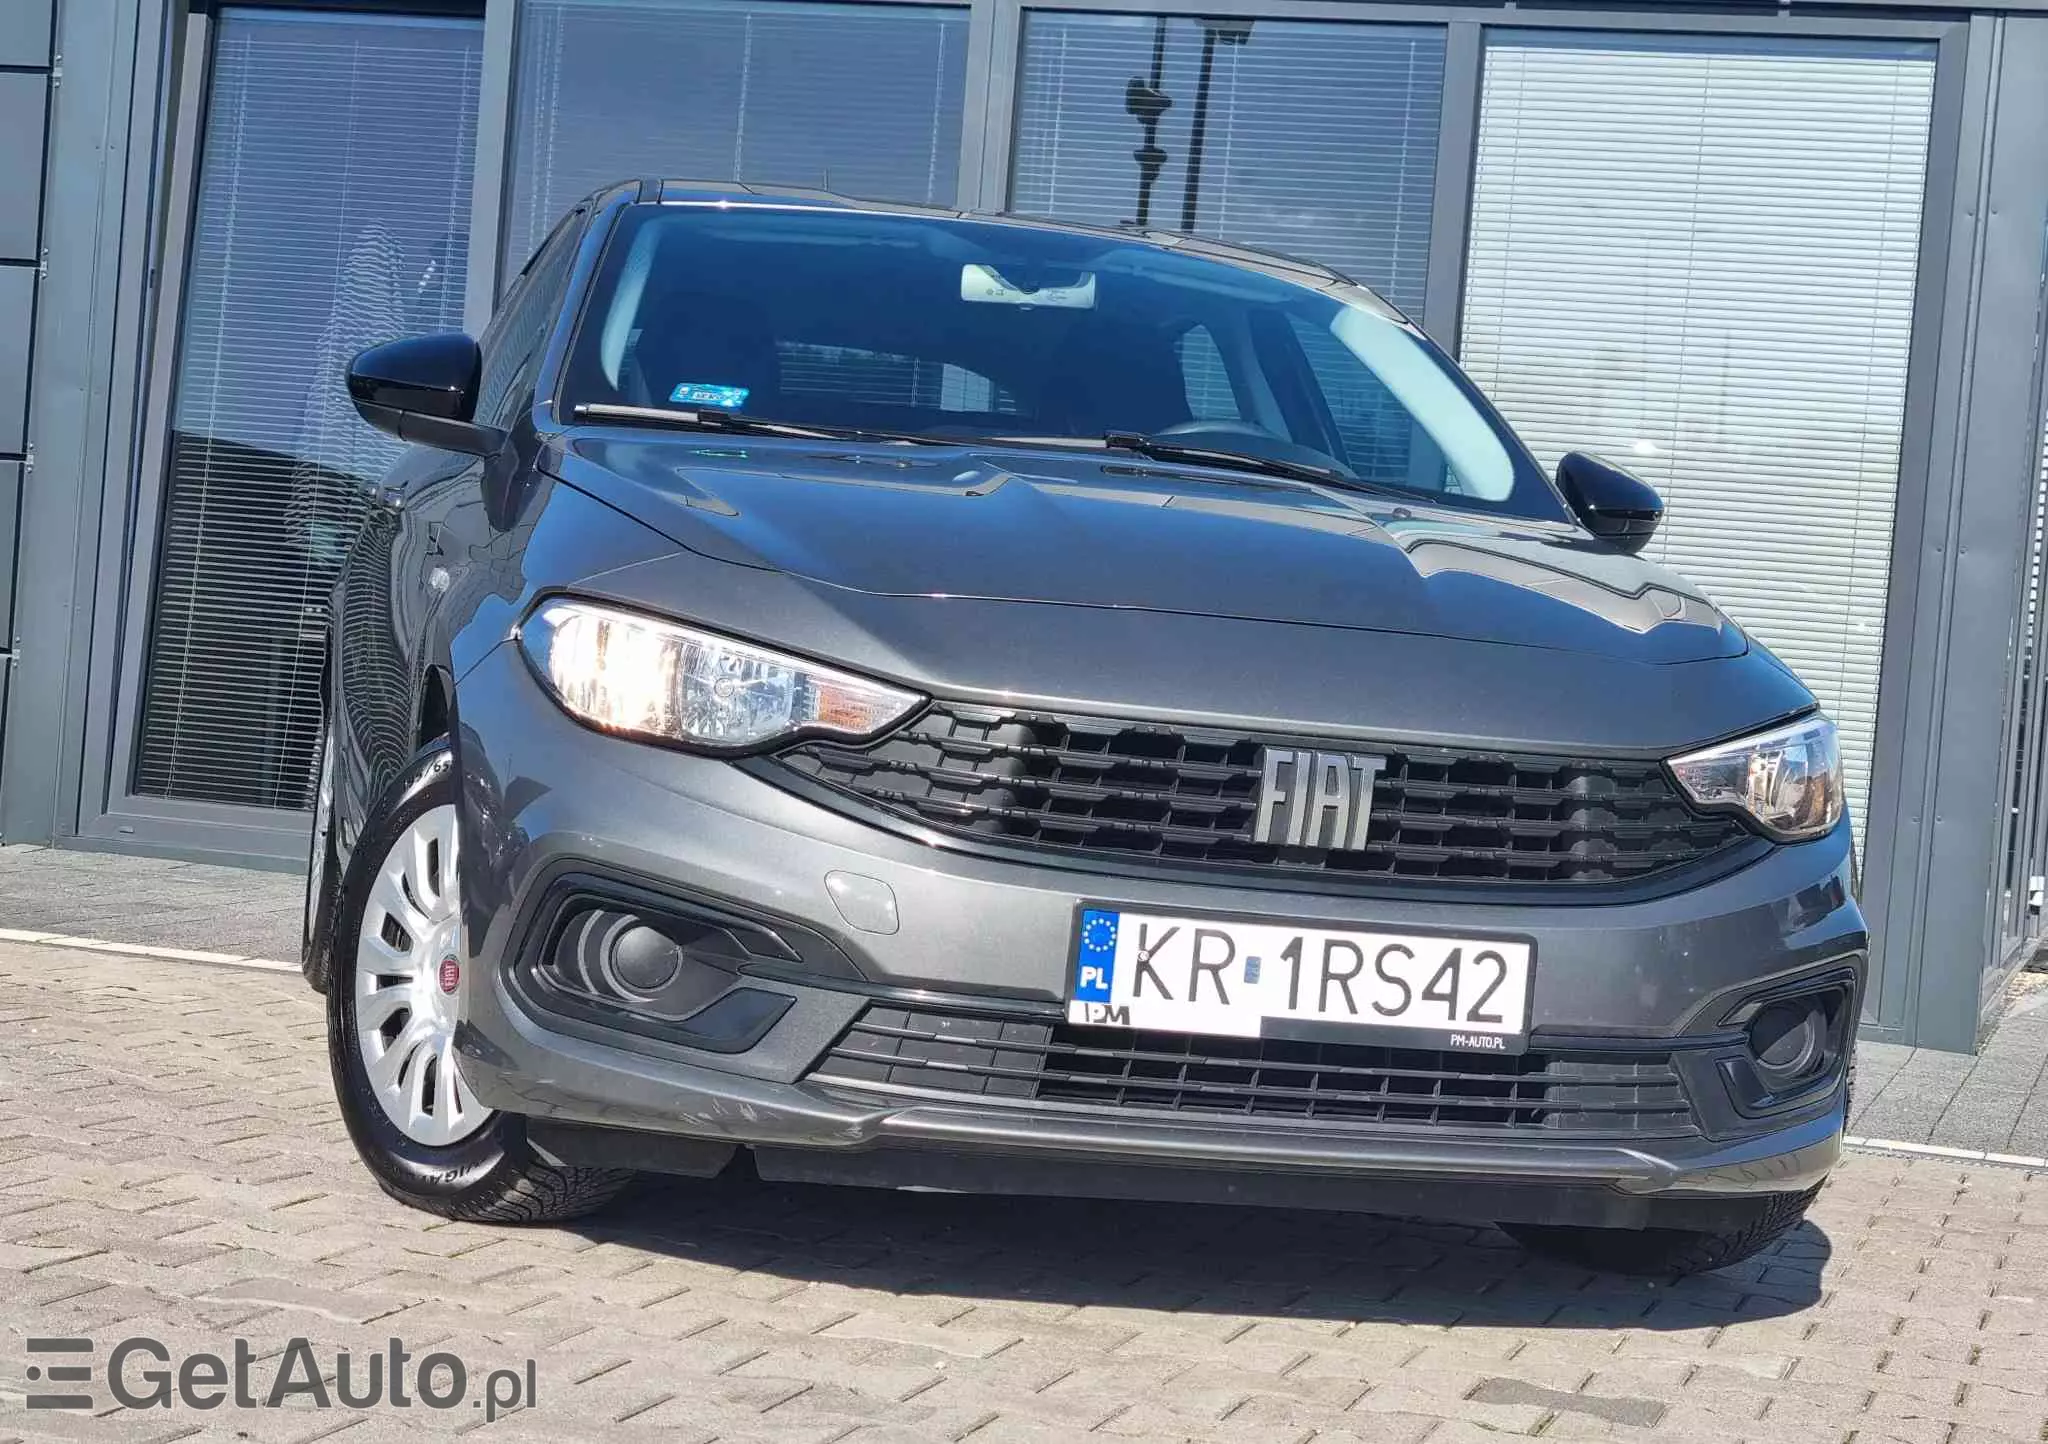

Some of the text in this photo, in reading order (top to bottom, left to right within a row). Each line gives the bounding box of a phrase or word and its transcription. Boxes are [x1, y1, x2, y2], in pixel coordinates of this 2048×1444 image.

[1253, 748, 1388, 852] FIAT
[1080, 965, 1109, 990] PL
[1132, 923, 1508, 1024] KR 1RS42
[1450, 1033, 1506, 1050] PM-AUTO.PL
